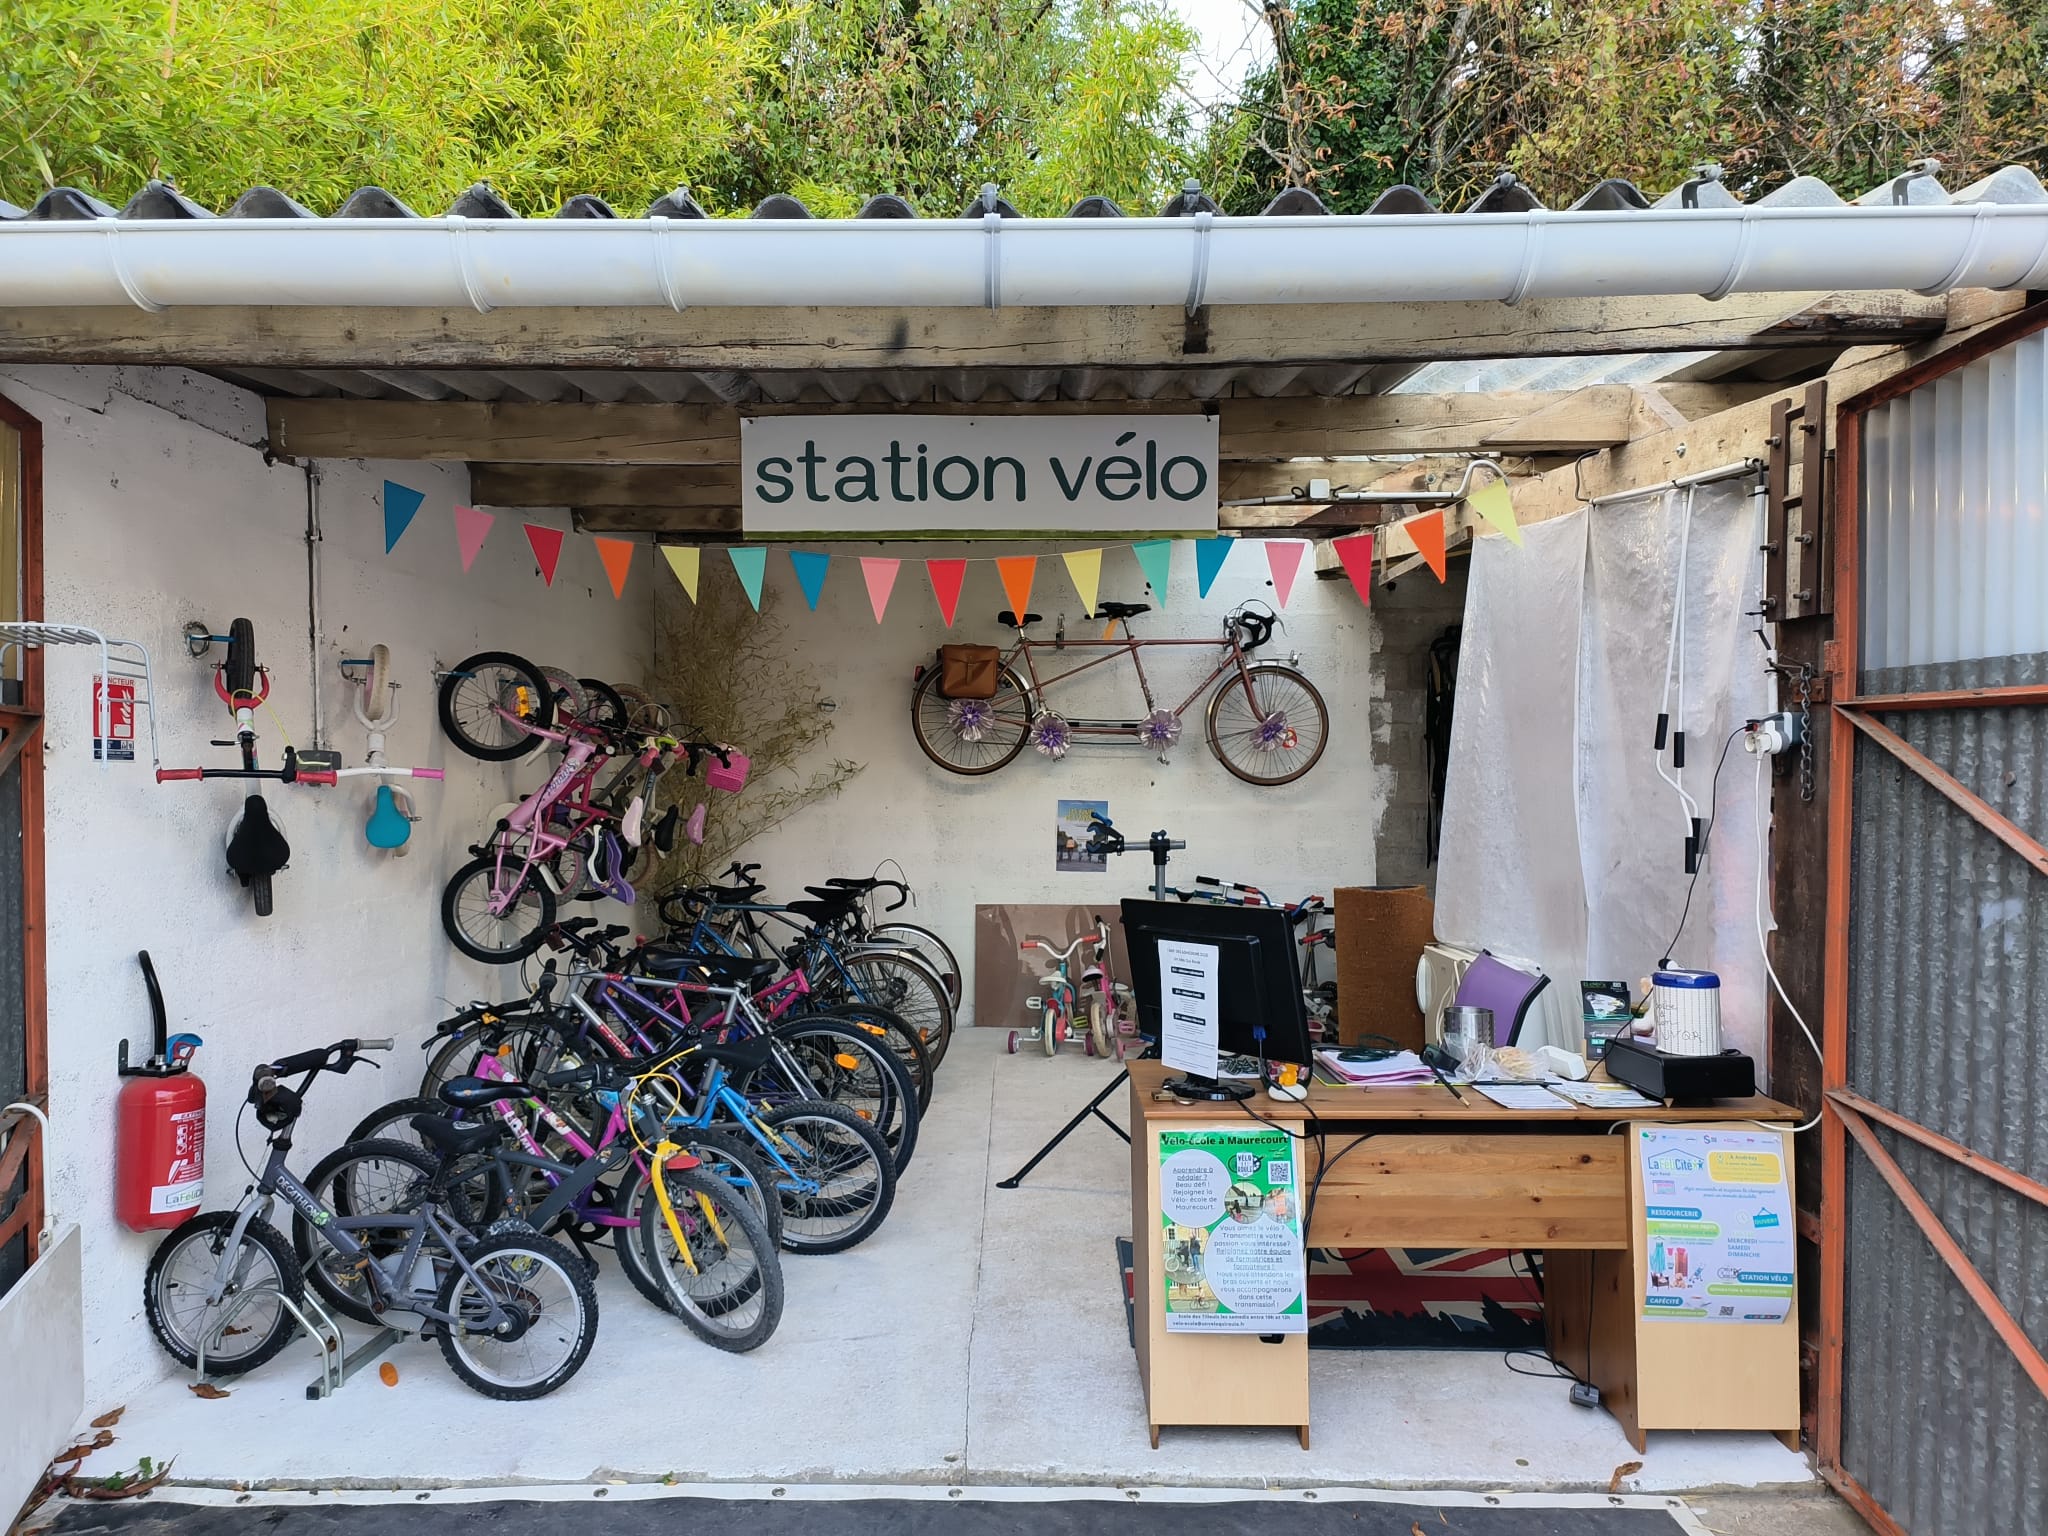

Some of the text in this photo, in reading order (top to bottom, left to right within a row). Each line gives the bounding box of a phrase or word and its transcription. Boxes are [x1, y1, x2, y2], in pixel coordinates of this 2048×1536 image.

[756, 432, 1207, 503] station vélo
[93, 675, 135, 687] EXNCTEUR
[1163, 1136, 1288, 1146] Vélo-école à Maurecourt
[276, 1176, 320, 1218] DECATHLON
[1771, 1274, 1788, 1282] VÉLO
